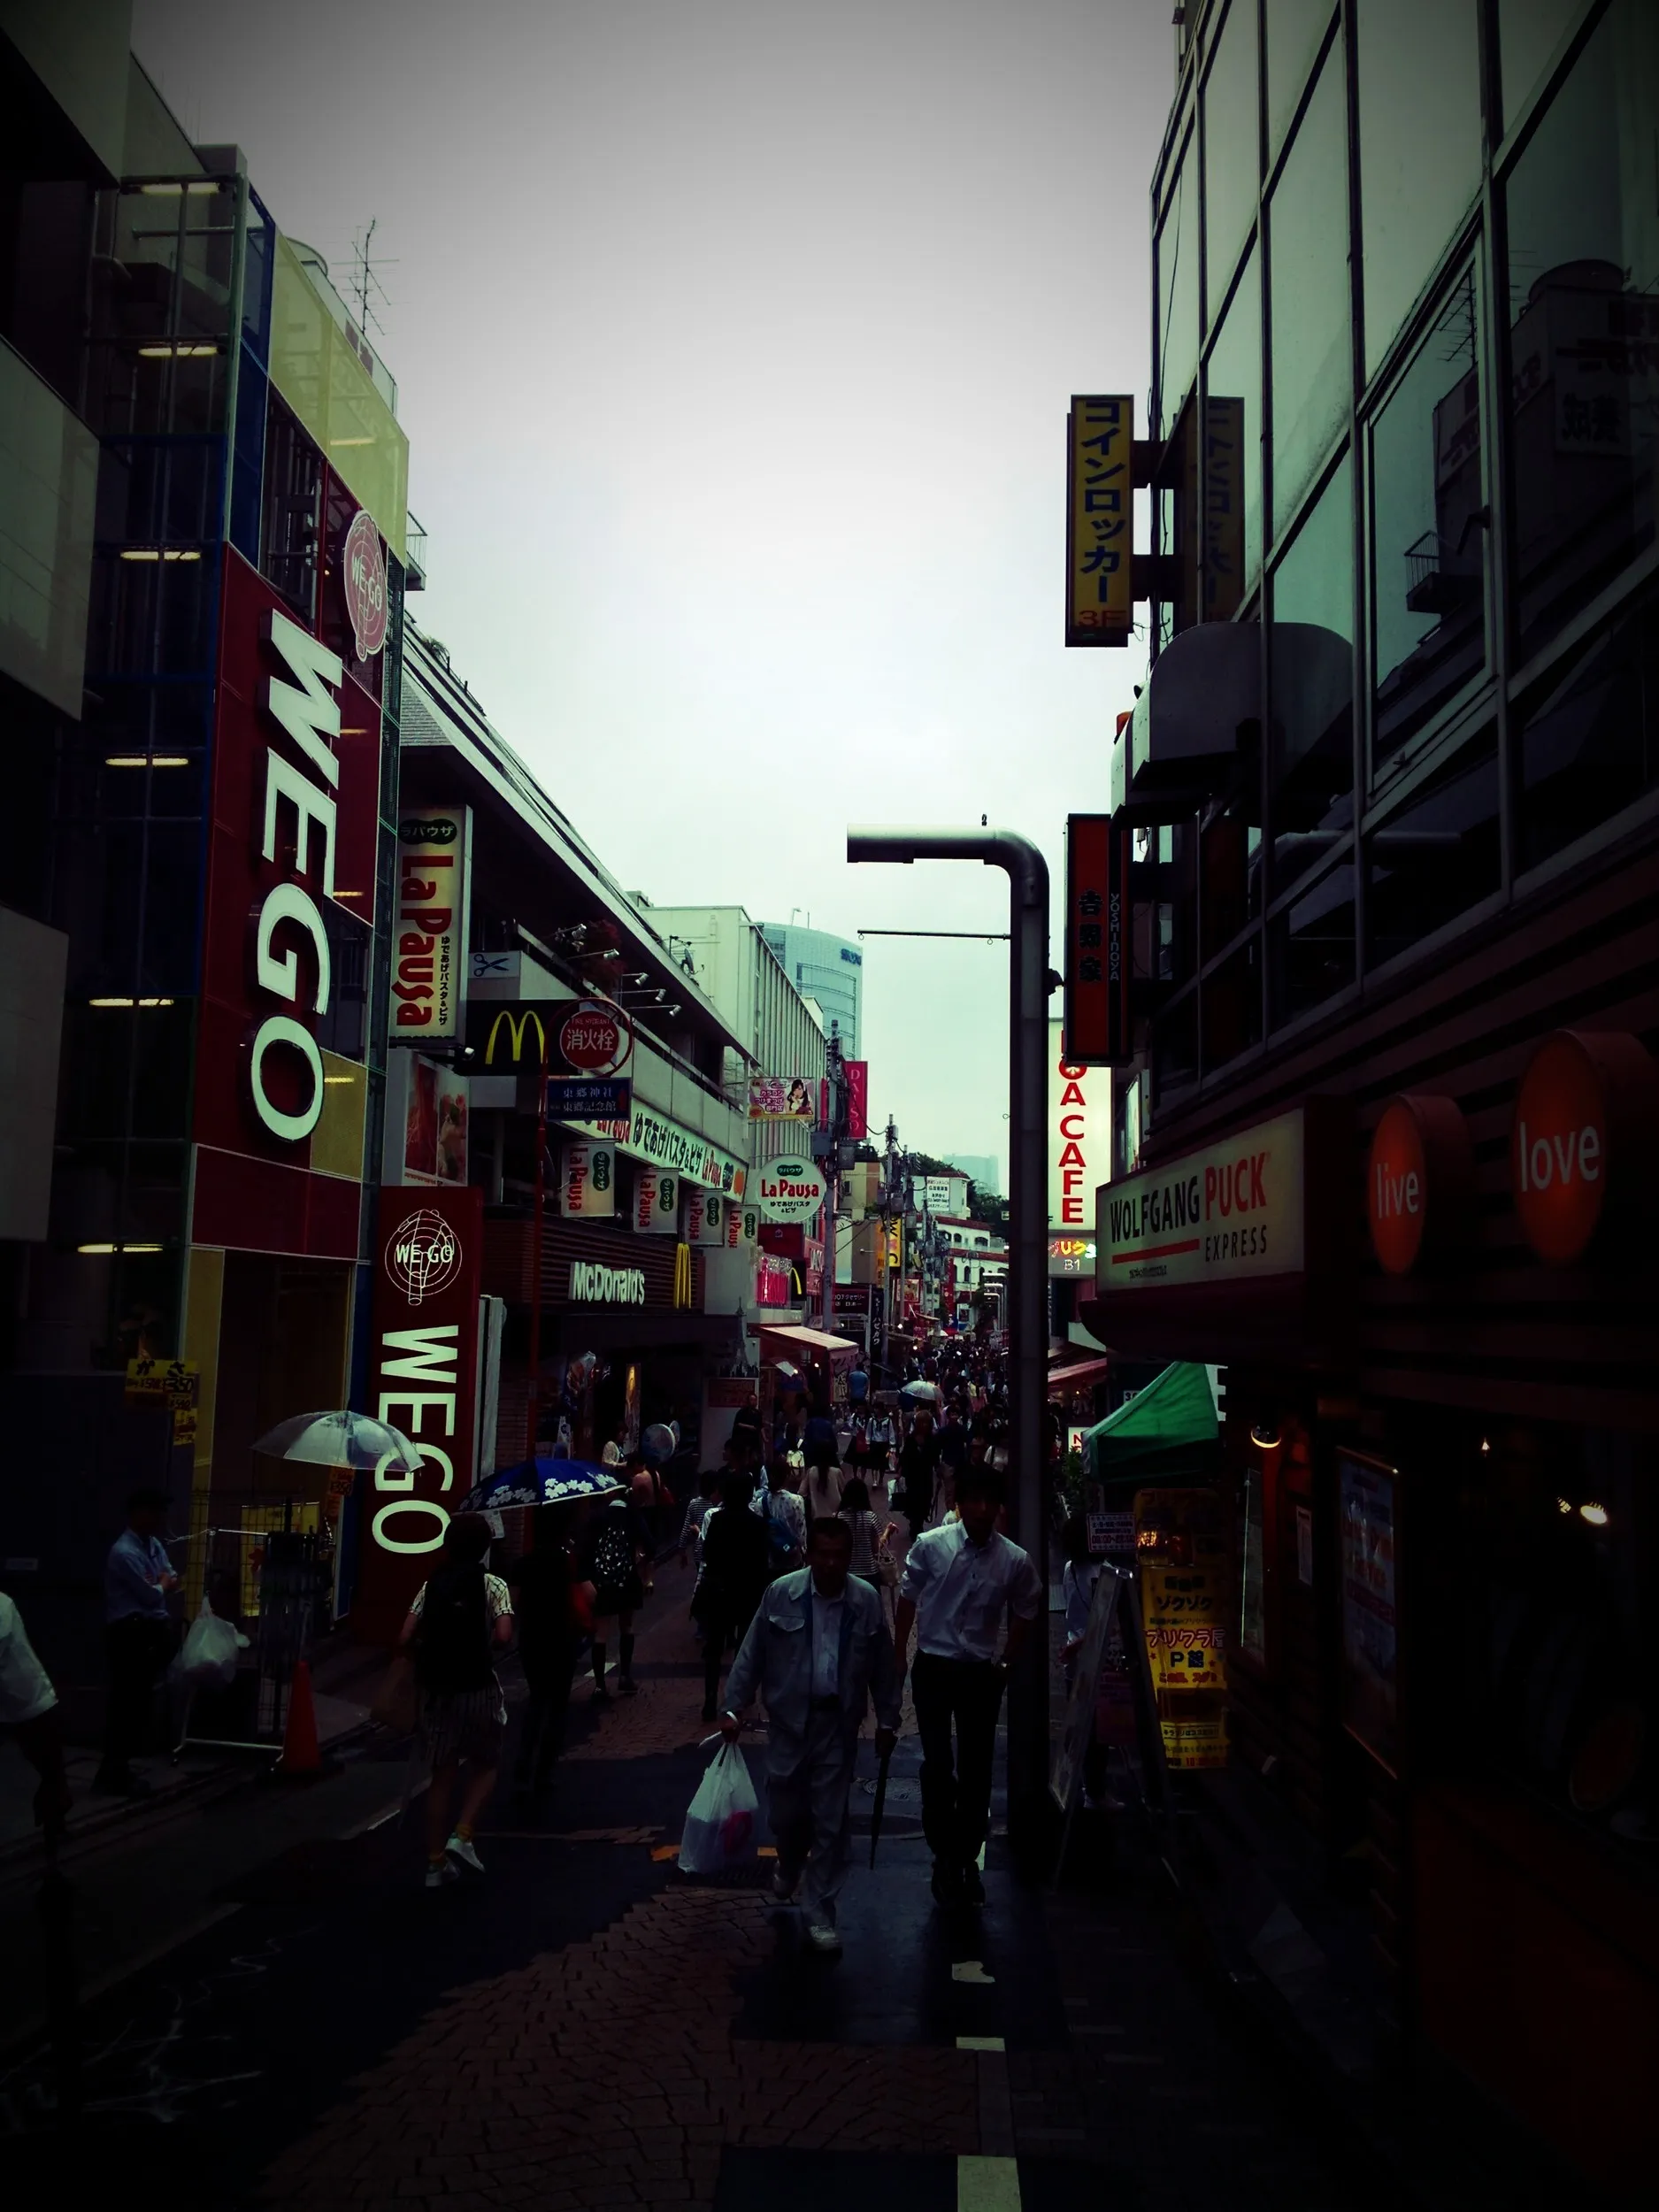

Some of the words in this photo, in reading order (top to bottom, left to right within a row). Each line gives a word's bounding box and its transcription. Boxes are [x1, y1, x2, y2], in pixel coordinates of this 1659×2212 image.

[1081, 402, 1125, 603] コインロッカー
[1079, 610, 1126, 626] 3F
[250, 607, 343, 1141] WEGO
[401, 856, 454, 901] La
[391, 908, 452, 1026] Pausa
[1110, 893, 1121, 981] YOSHINOYA
[566, 1028, 615, 1051] 消火栓
[564, 1086, 613, 1098] 東郷神社
[761, 1179, 777, 1197] La
[780, 1179, 819, 1199] Pausa
[1058, 1115, 1087, 1223] CAFE
[1110, 1175, 1200, 1243] WOLFGANG
[1204, 1151, 1267, 1222] PUCK
[1377, 1163, 1420, 1218] live
[1519, 1121, 1600, 1192] love
[572, 1260, 646, 1305] McDonald's
[1205, 1225, 1267, 1262] EXPRESS
[372, 1325, 459, 1555] WEGO
